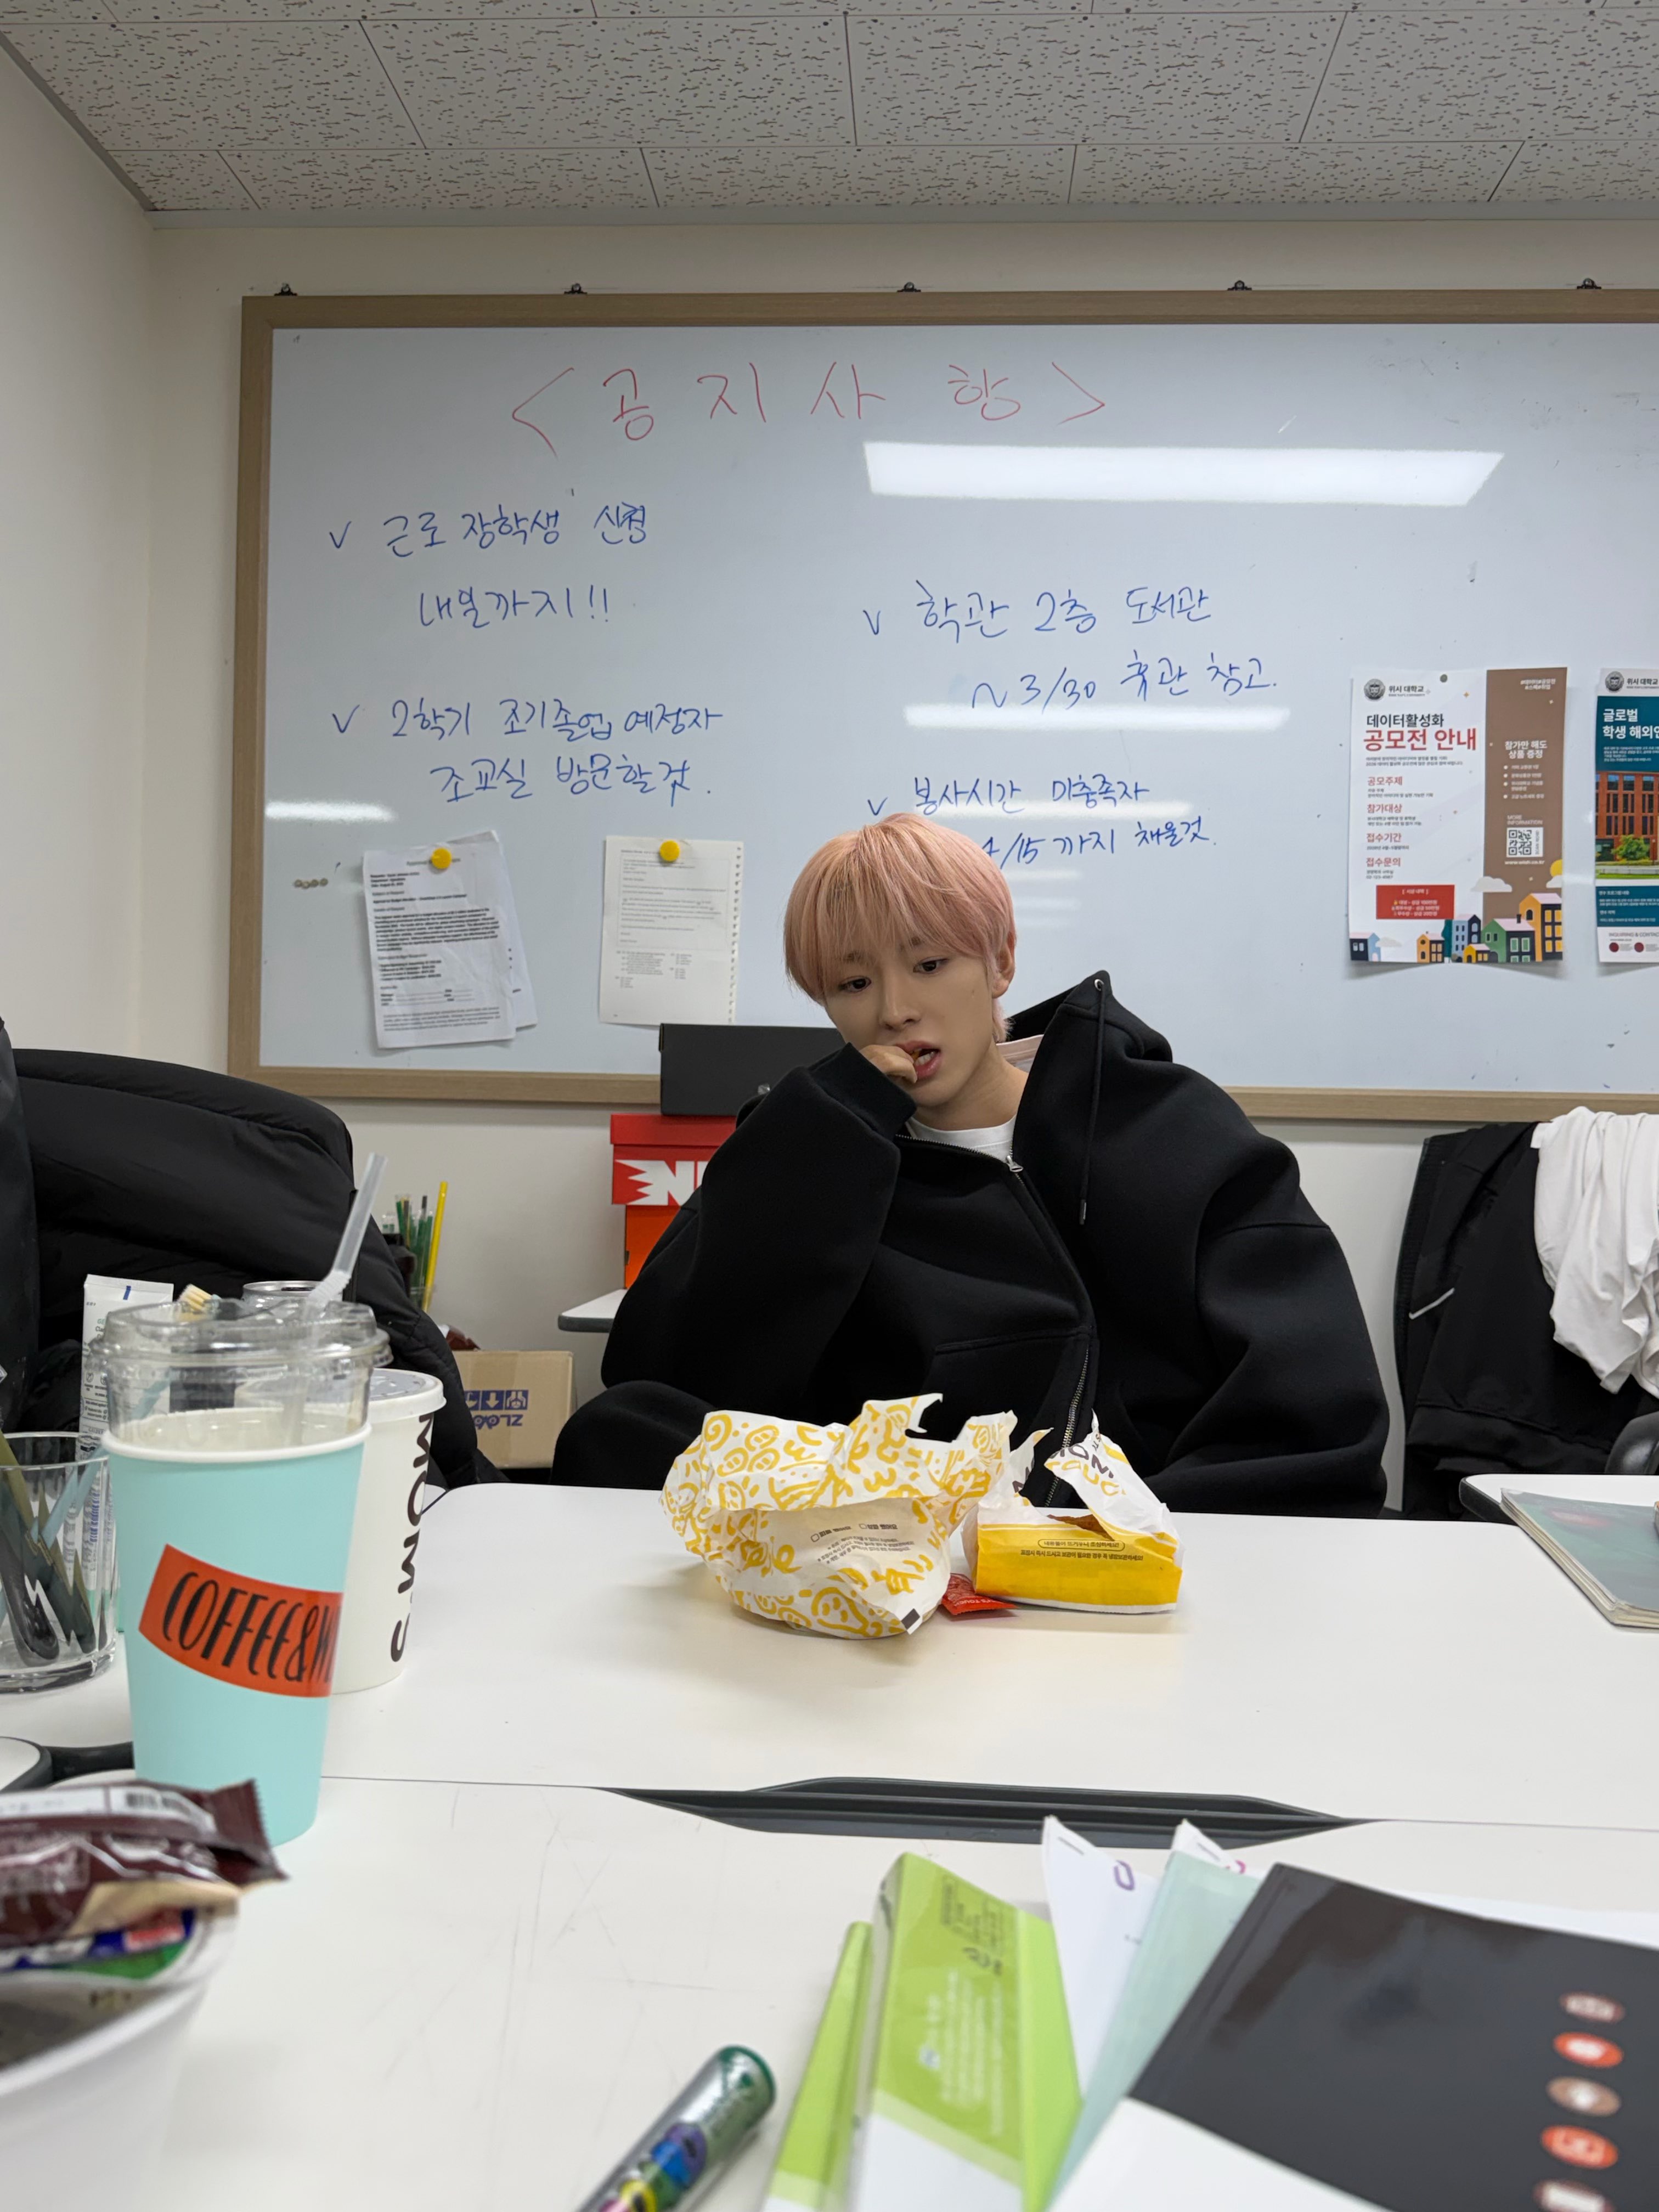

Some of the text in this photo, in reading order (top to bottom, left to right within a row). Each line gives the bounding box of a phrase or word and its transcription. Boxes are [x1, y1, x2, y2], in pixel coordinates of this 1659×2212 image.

[383, 513, 446, 557] 근로
[461, 504, 559, 549] 장학생
[420, 585, 609, 628] 내일까지!!
[916, 580, 1211, 643] 학관 2층 도서관
[392, 698, 723, 741] 2학기 조기졸업 예정자
[1367, 714, 1444, 727] 데이터활성화
[1603, 708, 1638, 723] 글로벌
[1602, 725, 1626, 739] 학생
[1363, 728, 1476, 752] 공모전 안내
[1531, 740, 1548, 749] 해도
[1509, 749, 1525, 759] 상품
[430, 758, 532, 802] 조교실
[1368, 776, 1403, 786] 공모주제
[915, 774, 1150, 815] 봉사시간 미충족자
[1367, 803, 1402, 814] 참가대상
[1367, 833, 1401, 843] 접수기간
[1366, 857, 1401, 867] 접수문의
